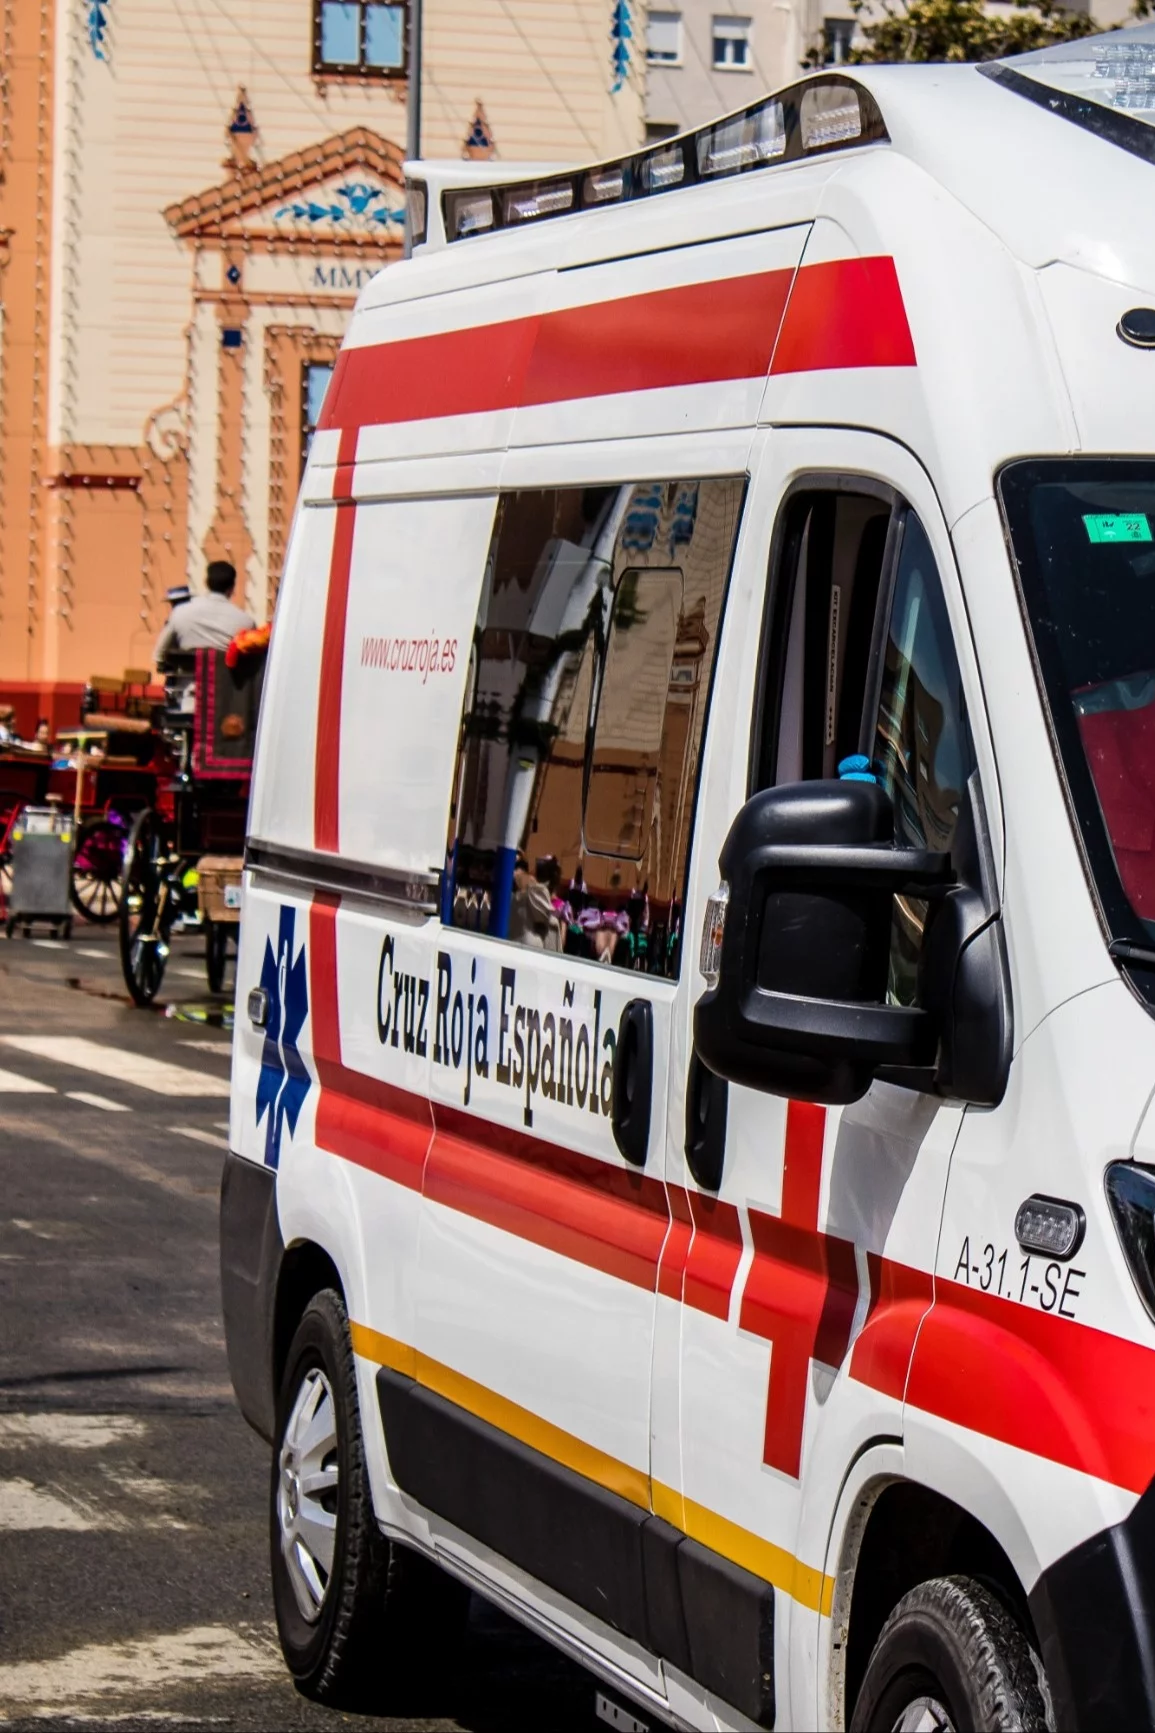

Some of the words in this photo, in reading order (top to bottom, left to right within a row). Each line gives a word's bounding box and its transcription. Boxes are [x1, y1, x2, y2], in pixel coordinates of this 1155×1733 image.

[361, 628, 458, 685] www.cruzroja.es
[377, 934, 430, 1058] Cruz
[433, 951, 489, 1106] Roja
[496, 966, 617, 1128] Española
[954, 1235, 1087, 1318] A-31.1-SE
